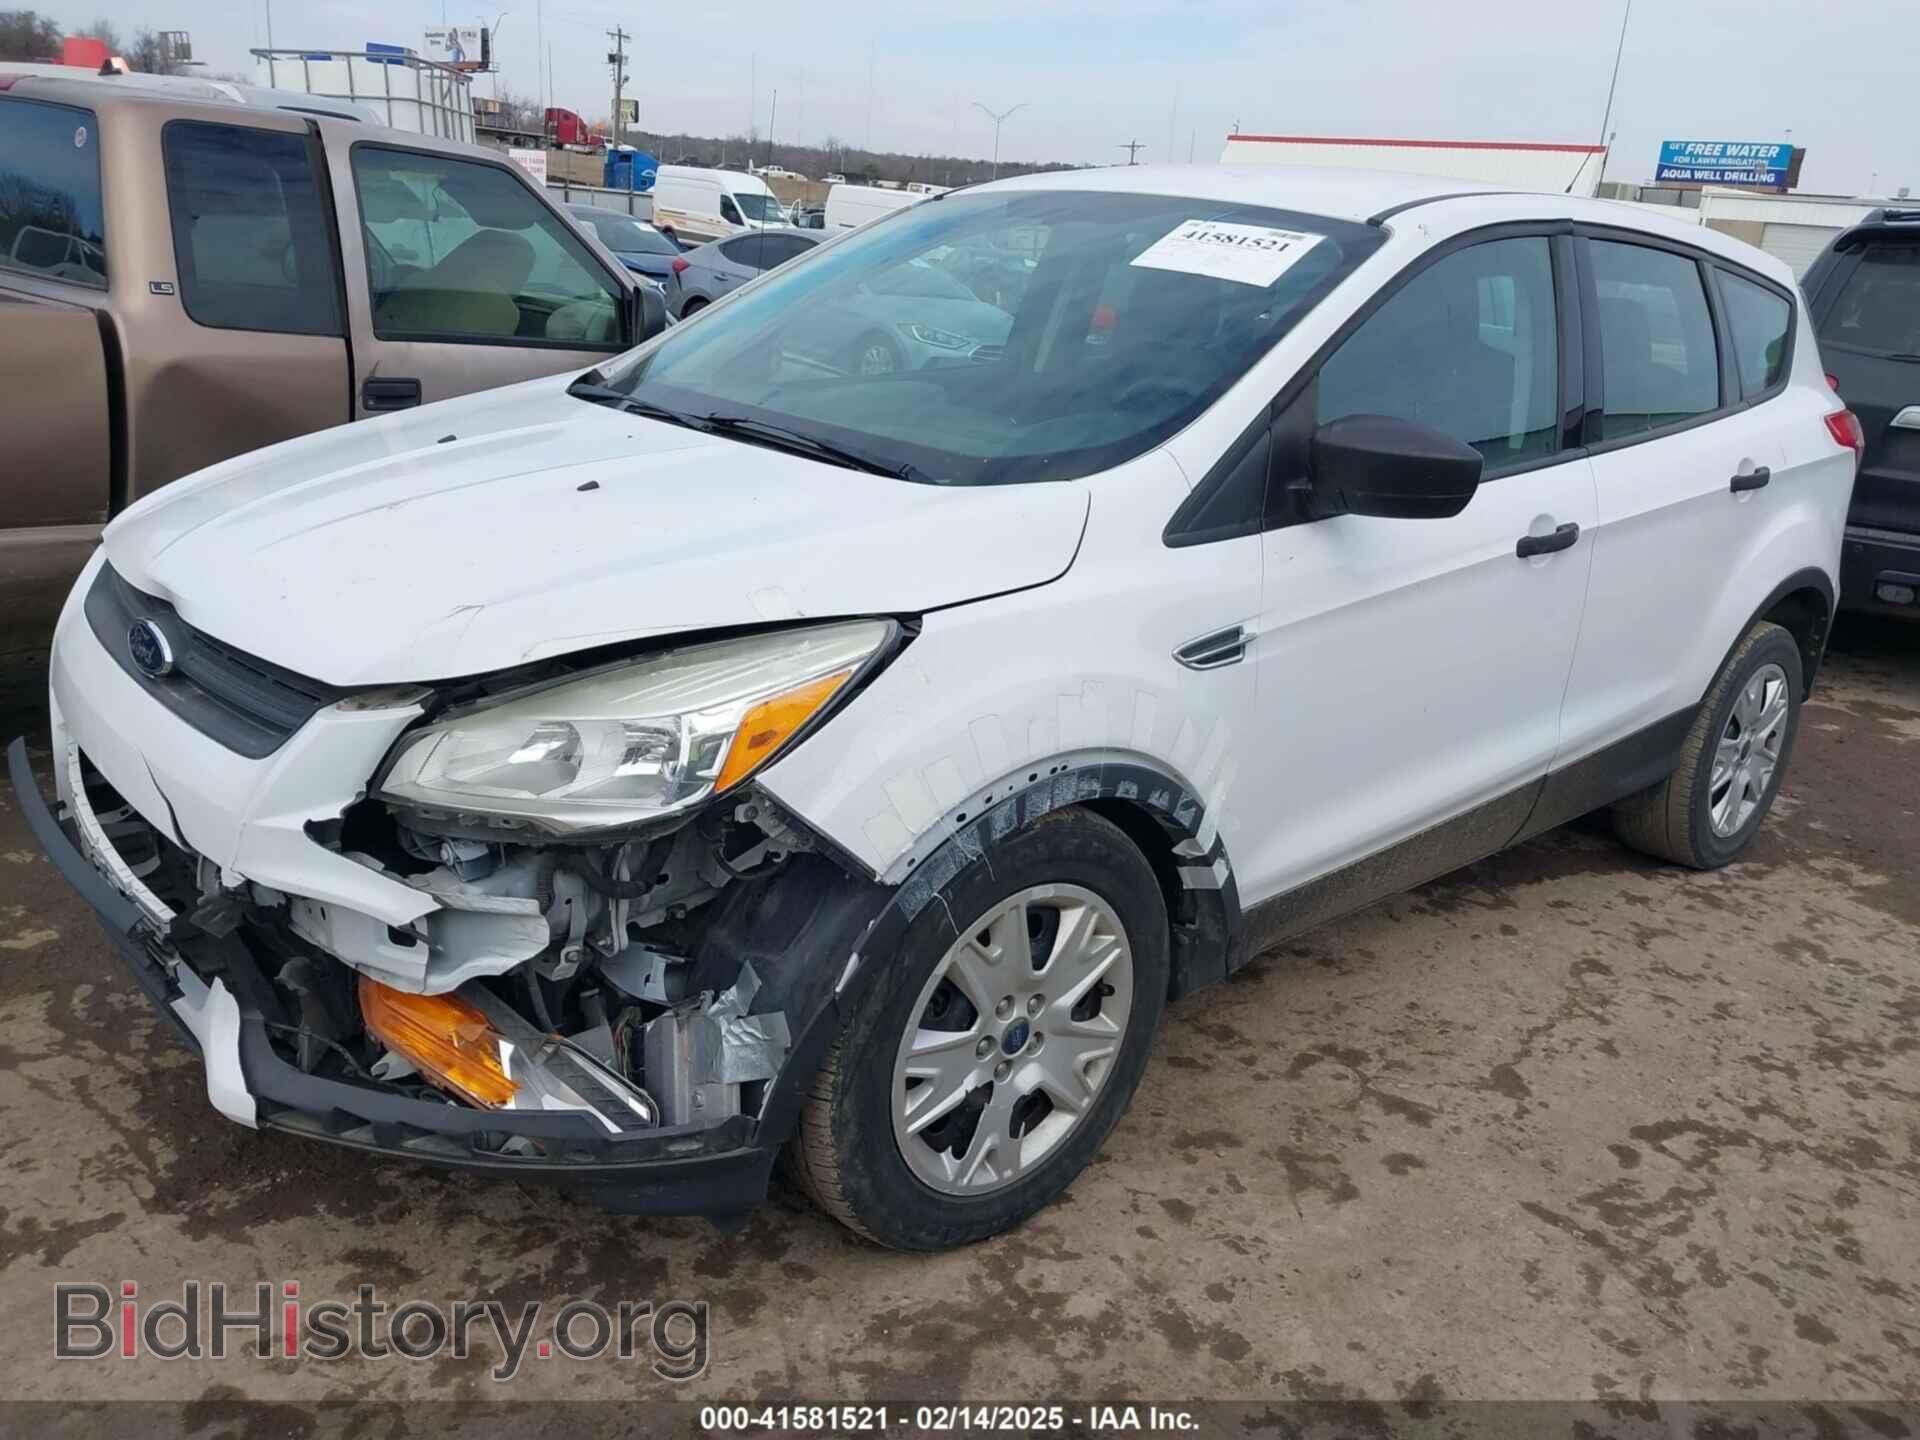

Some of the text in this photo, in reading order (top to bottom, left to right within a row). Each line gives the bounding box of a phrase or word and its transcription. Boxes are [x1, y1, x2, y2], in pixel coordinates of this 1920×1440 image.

[1685, 143, 1723, 156] FREE
[1726, 145, 1780, 158] WATER
[1673, 156, 1691, 164] FOR
[1692, 157, 1717, 165] LAWN
[1661, 169, 1776, 183] AQUA WELL DRILLING
[1183, 231, 1291, 252] 41581521
